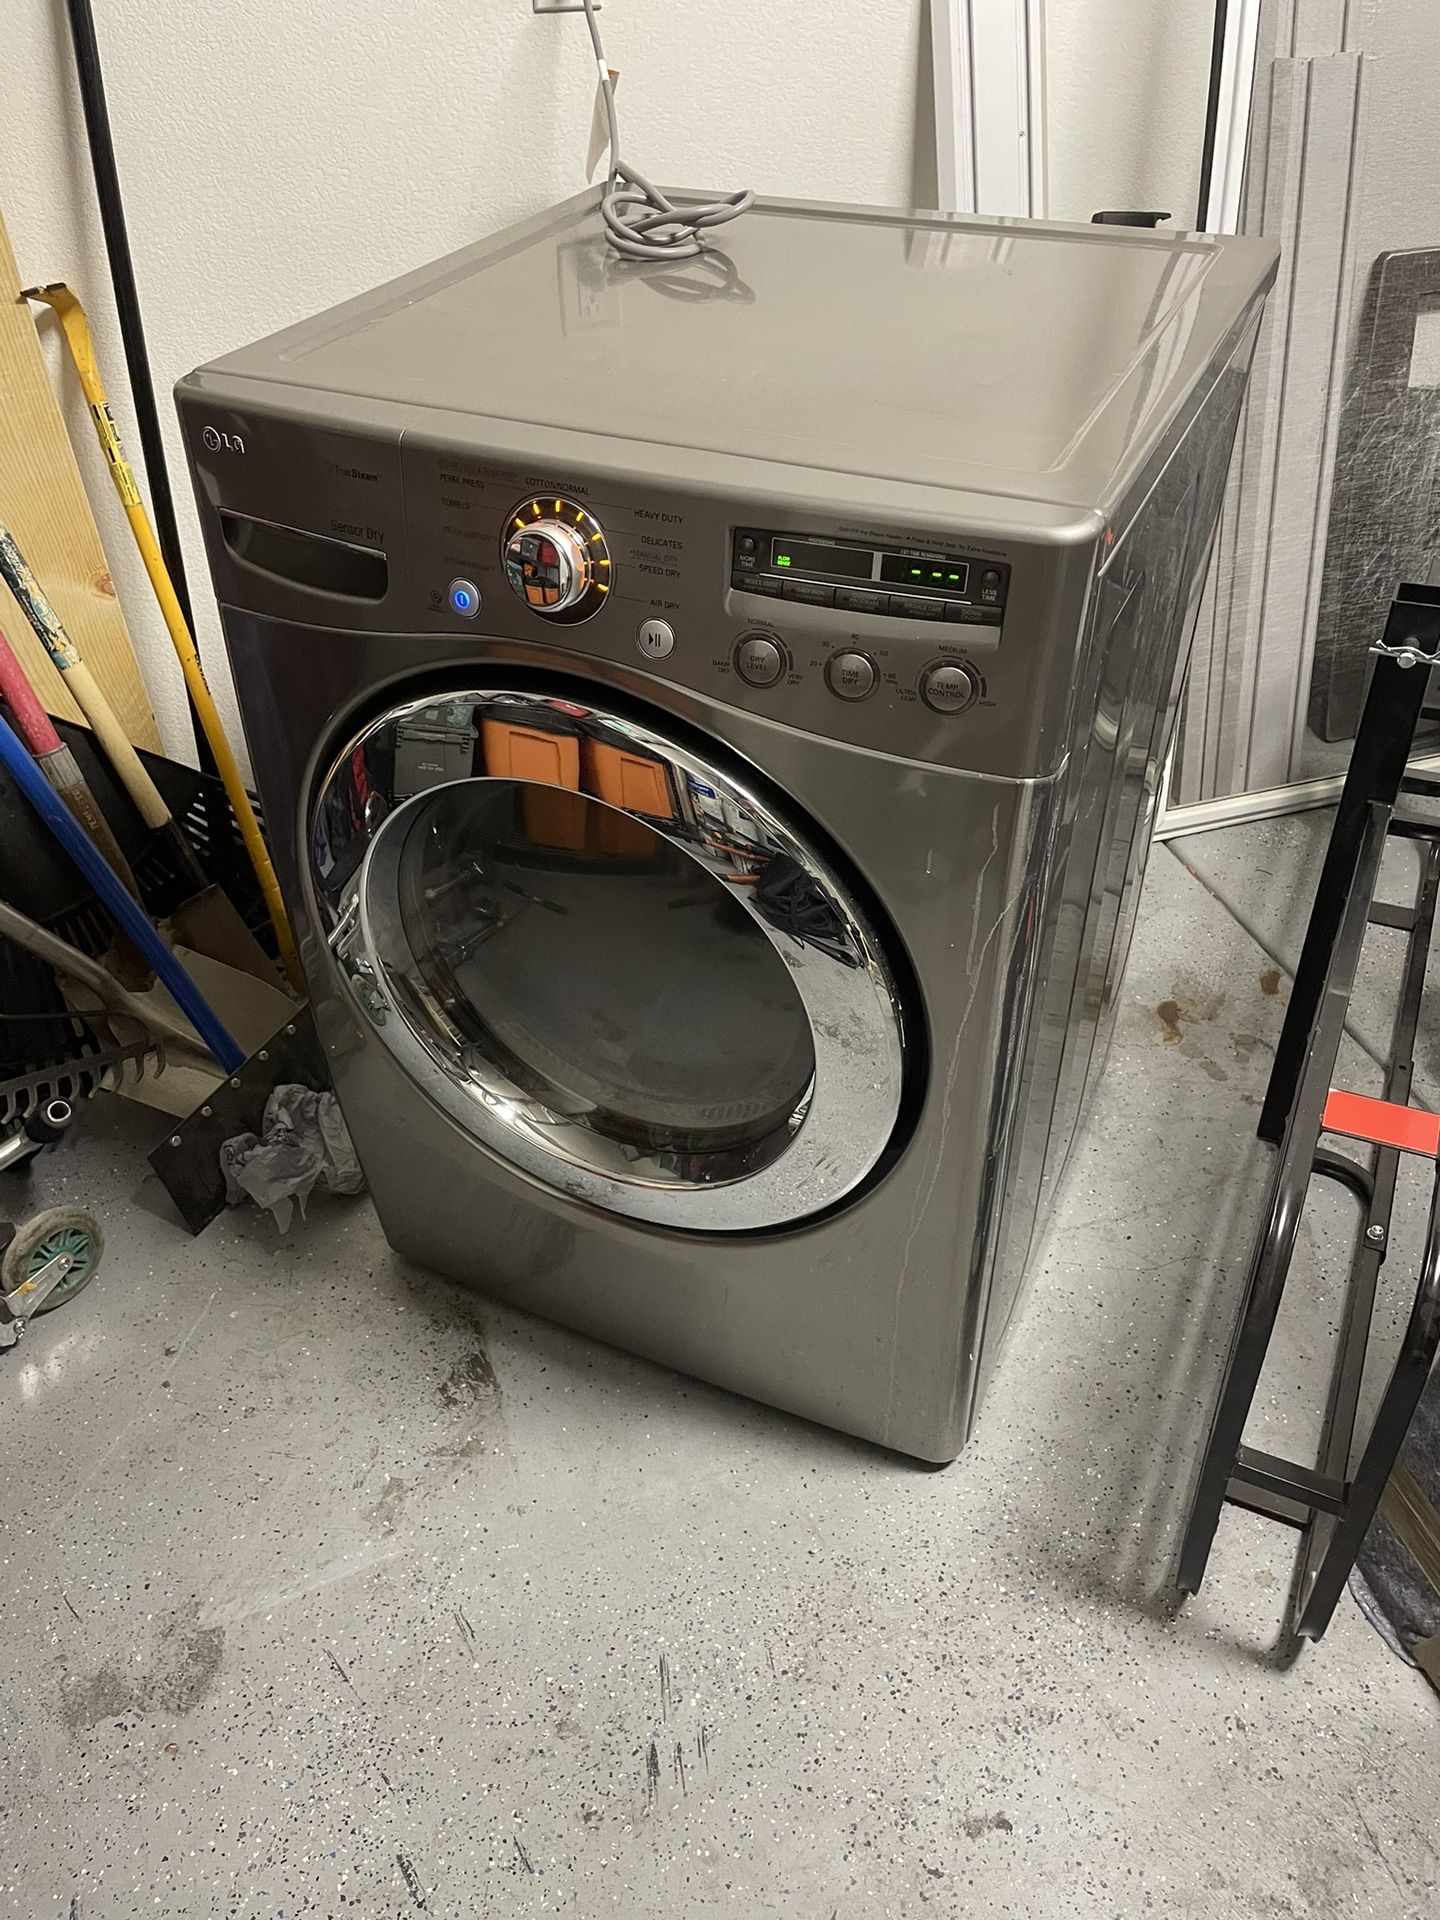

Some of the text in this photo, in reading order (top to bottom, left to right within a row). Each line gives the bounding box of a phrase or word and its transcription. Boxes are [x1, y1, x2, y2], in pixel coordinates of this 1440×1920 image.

[634, 509, 685, 525] HEAVY DUTY
[330, 519, 385, 545] Sensor Dry
[640, 535, 683, 550] DELICATES
[739, 554, 755, 563] MORE
[638, 563, 681, 579] SPEED DRY
[982, 588, 998, 596] LESS
[982, 594, 996, 602] TIME
[650, 599, 680, 610] AIR DRY
[747, 617, 775, 628] NORMAL
[938, 644, 968, 654] MEDIUM
[750, 655, 765, 663] DRY
[746, 661, 768, 671] LEVEL
[842, 669, 860, 678] TIME
[842, 676, 858, 685] DRY
[936, 681, 959, 690] TEMP
[895, 688, 917, 696] ULTRA
[927, 687, 966, 699] CONTROL
[900, 694, 917, 702] LOW
